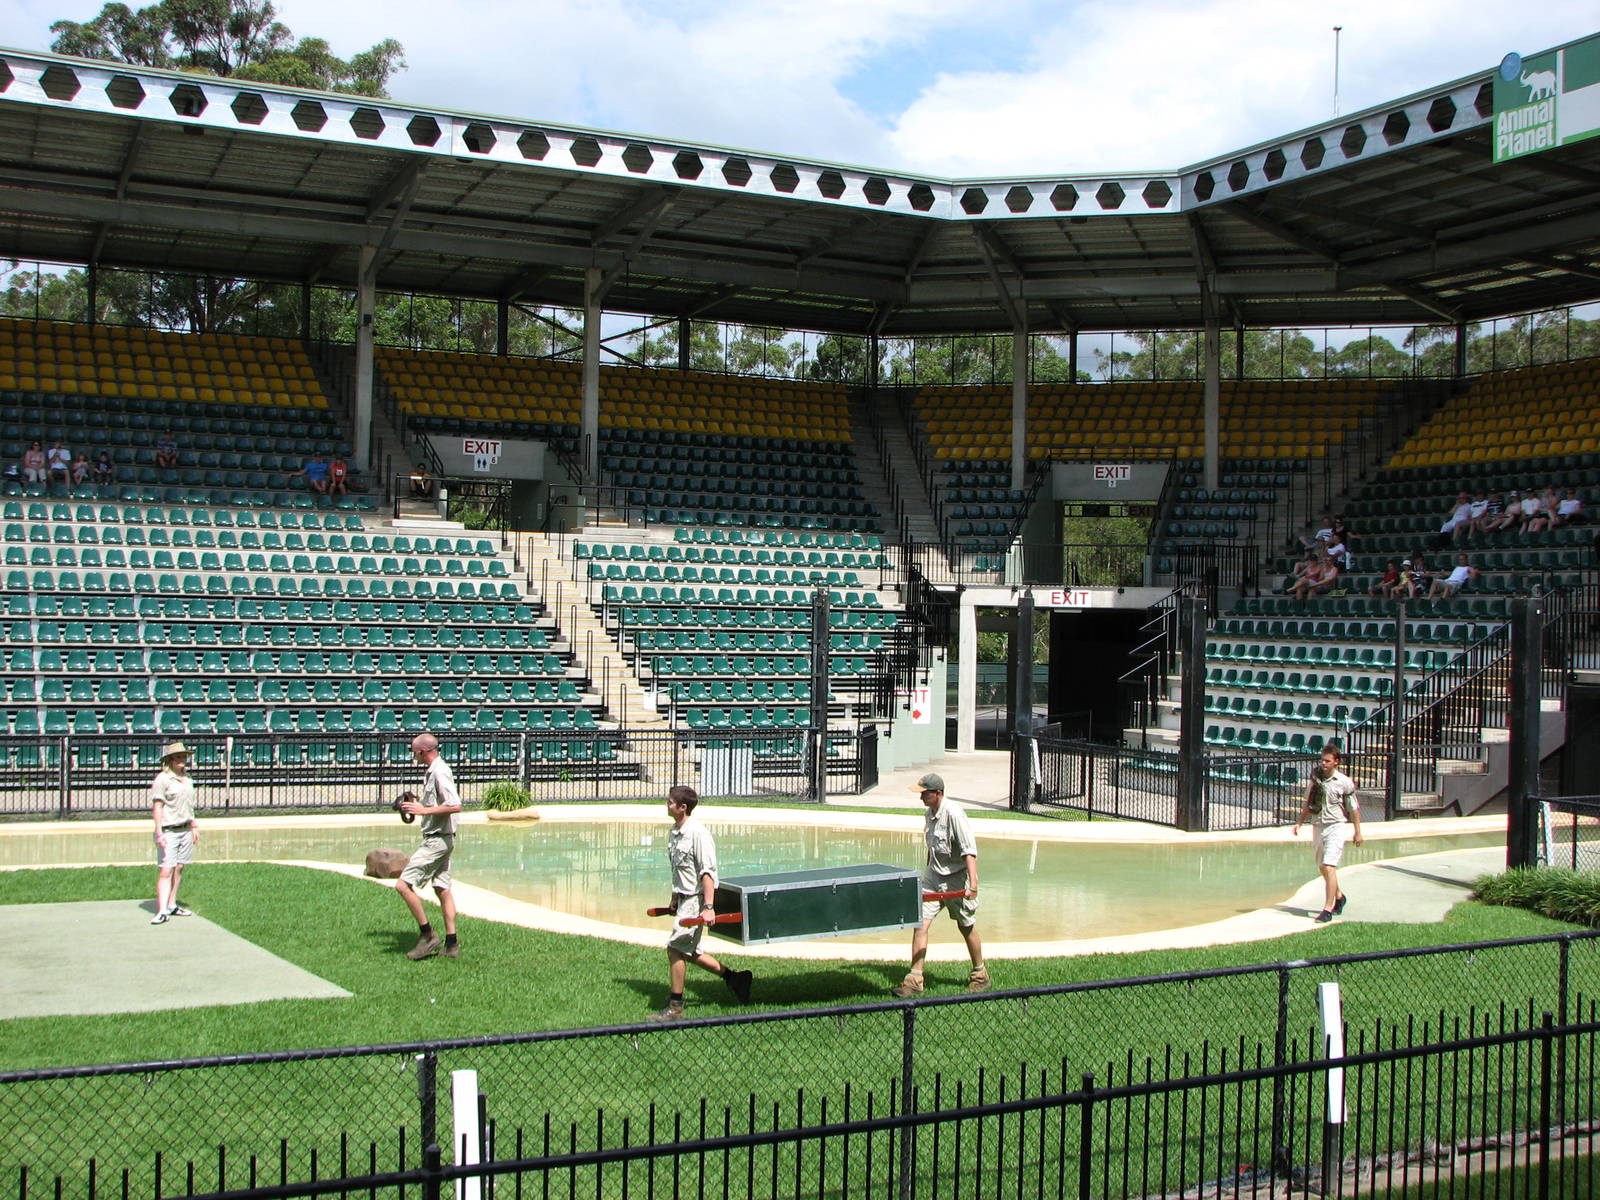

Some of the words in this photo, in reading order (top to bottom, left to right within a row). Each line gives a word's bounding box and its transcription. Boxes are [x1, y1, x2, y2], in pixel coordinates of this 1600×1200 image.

[1498, 97, 1554, 135] Animal
[1497, 122, 1553, 160] Planet
[464, 440, 500, 455] EXIT
[1095, 466, 1129, 479] EXIT
[1051, 591, 1089, 605] EXIT
